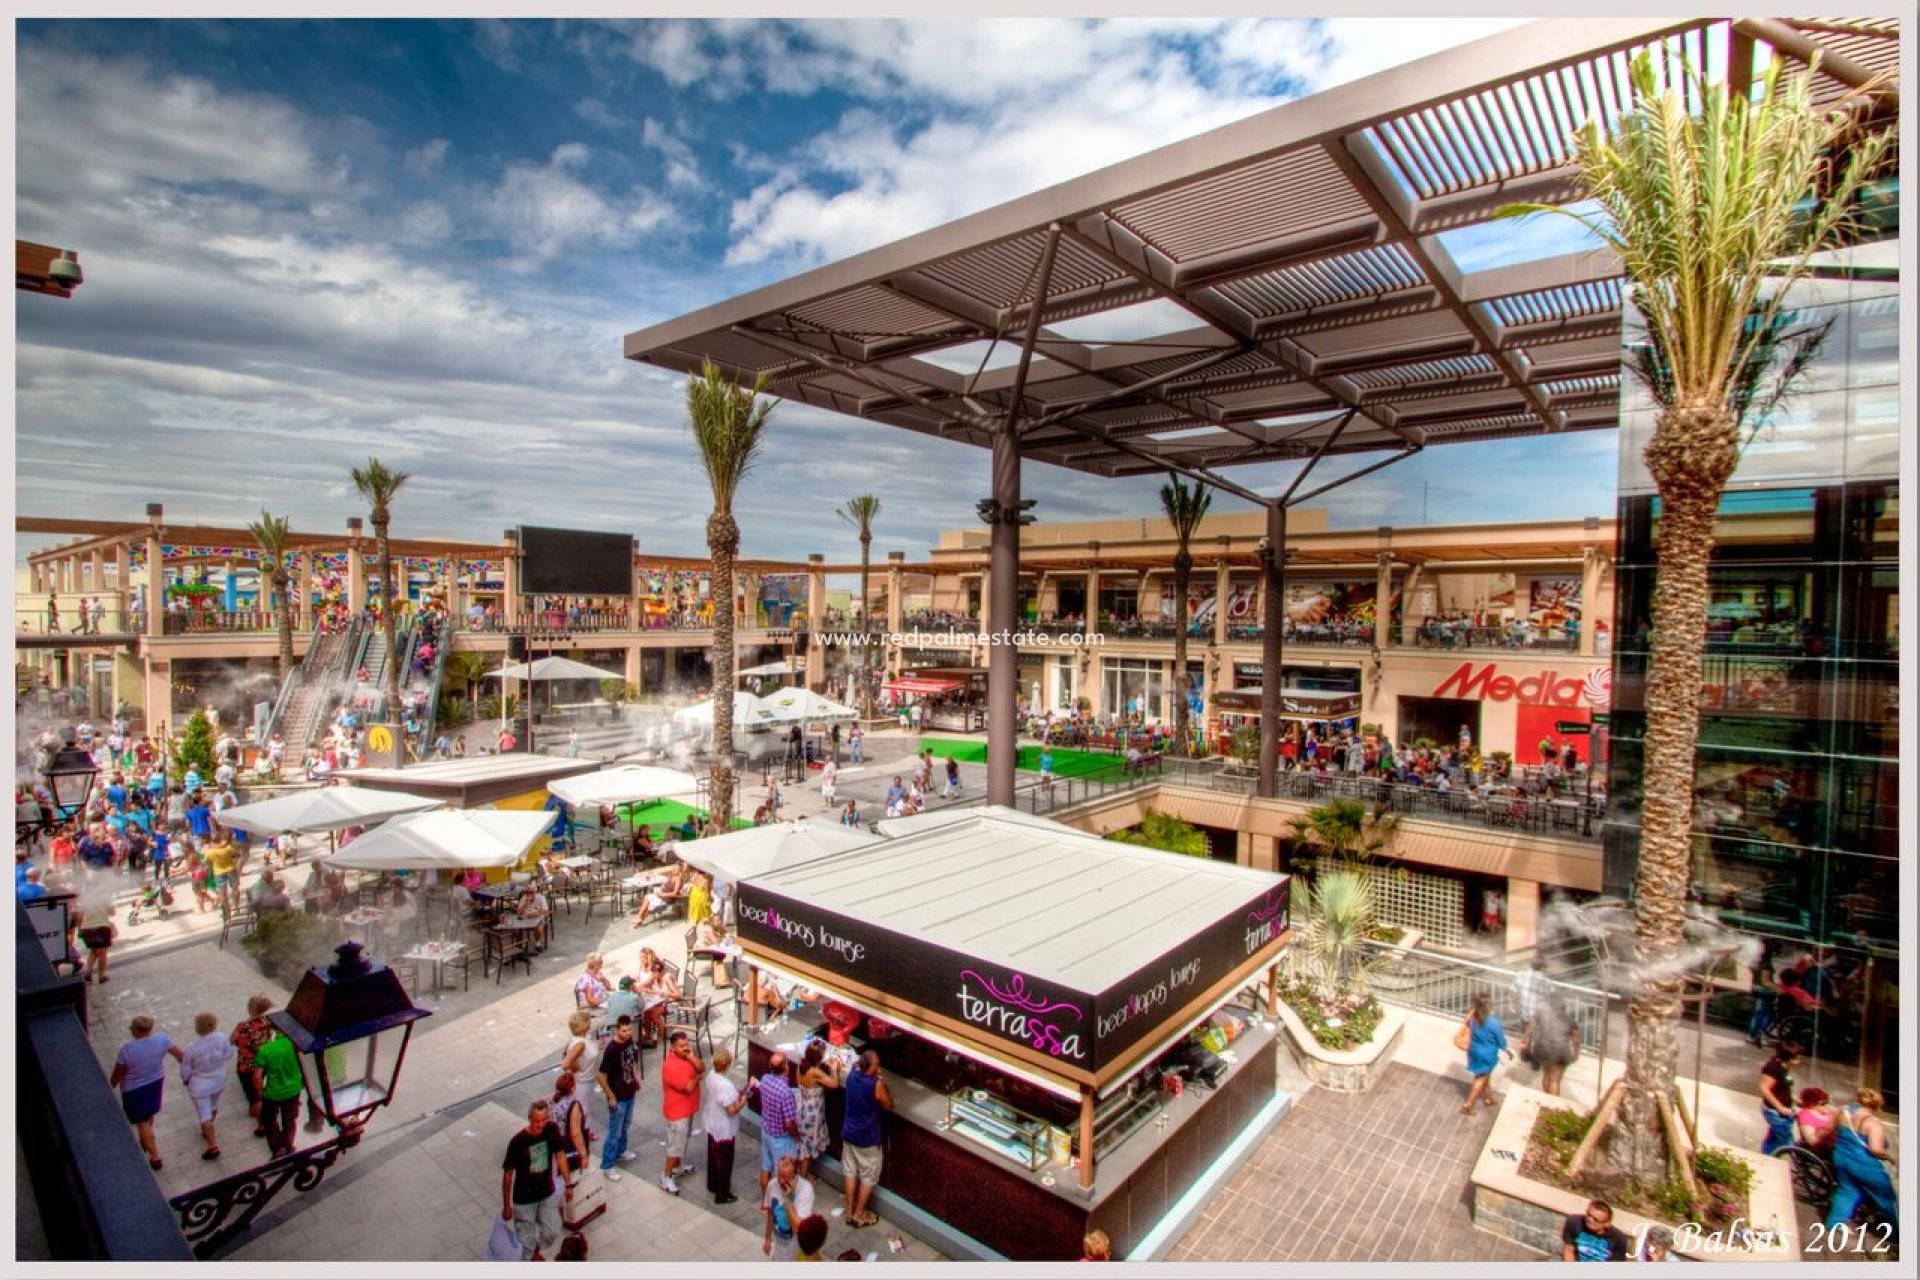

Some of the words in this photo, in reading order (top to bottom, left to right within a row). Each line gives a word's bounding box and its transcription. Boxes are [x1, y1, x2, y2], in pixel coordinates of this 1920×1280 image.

[1432, 662, 1585, 706] Media
[820, 925, 865, 963] lounge
[1244, 910, 1288, 955] terrassa
[956, 983, 1086, 1059] terrassa
